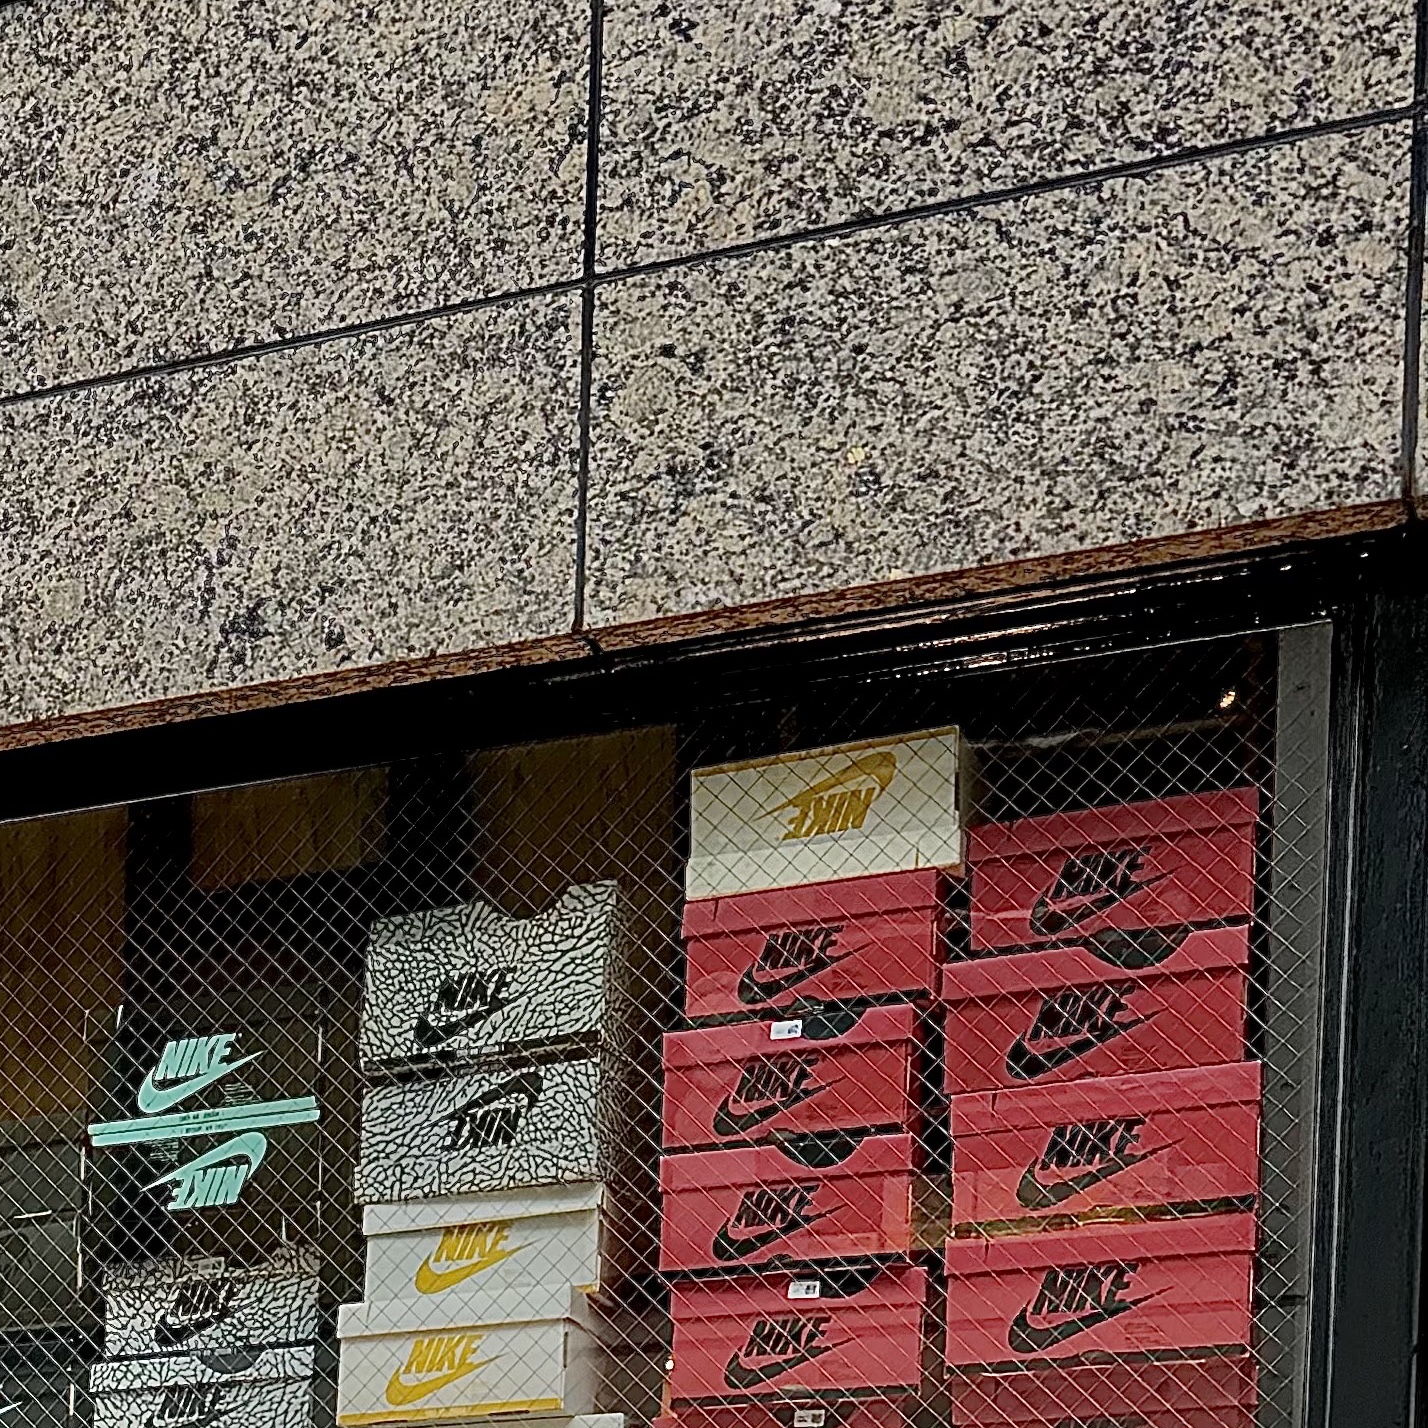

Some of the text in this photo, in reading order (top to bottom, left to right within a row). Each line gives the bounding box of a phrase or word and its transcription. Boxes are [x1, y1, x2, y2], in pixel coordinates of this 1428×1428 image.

[782, 788, 876, 840] NIKE
[1051, 845, 1151, 899] NIKE
[757, 925, 844, 971] NIKE
[1028, 982, 1137, 1041] NIKE
[154, 1033, 237, 1080] NIKE
[733, 1056, 820, 1103] NIKE
[1039, 1117, 1145, 1170] NIKE
[168, 1164, 249, 1210] NIKE
[731, 1185, 821, 1228] NIKE
[433, 1221, 513, 1263] NIKE
[1032, 1263, 1140, 1315] NIKE
[404, 1334, 485, 1375] NIKE
[744, 1316, 832, 1358] NIKE
